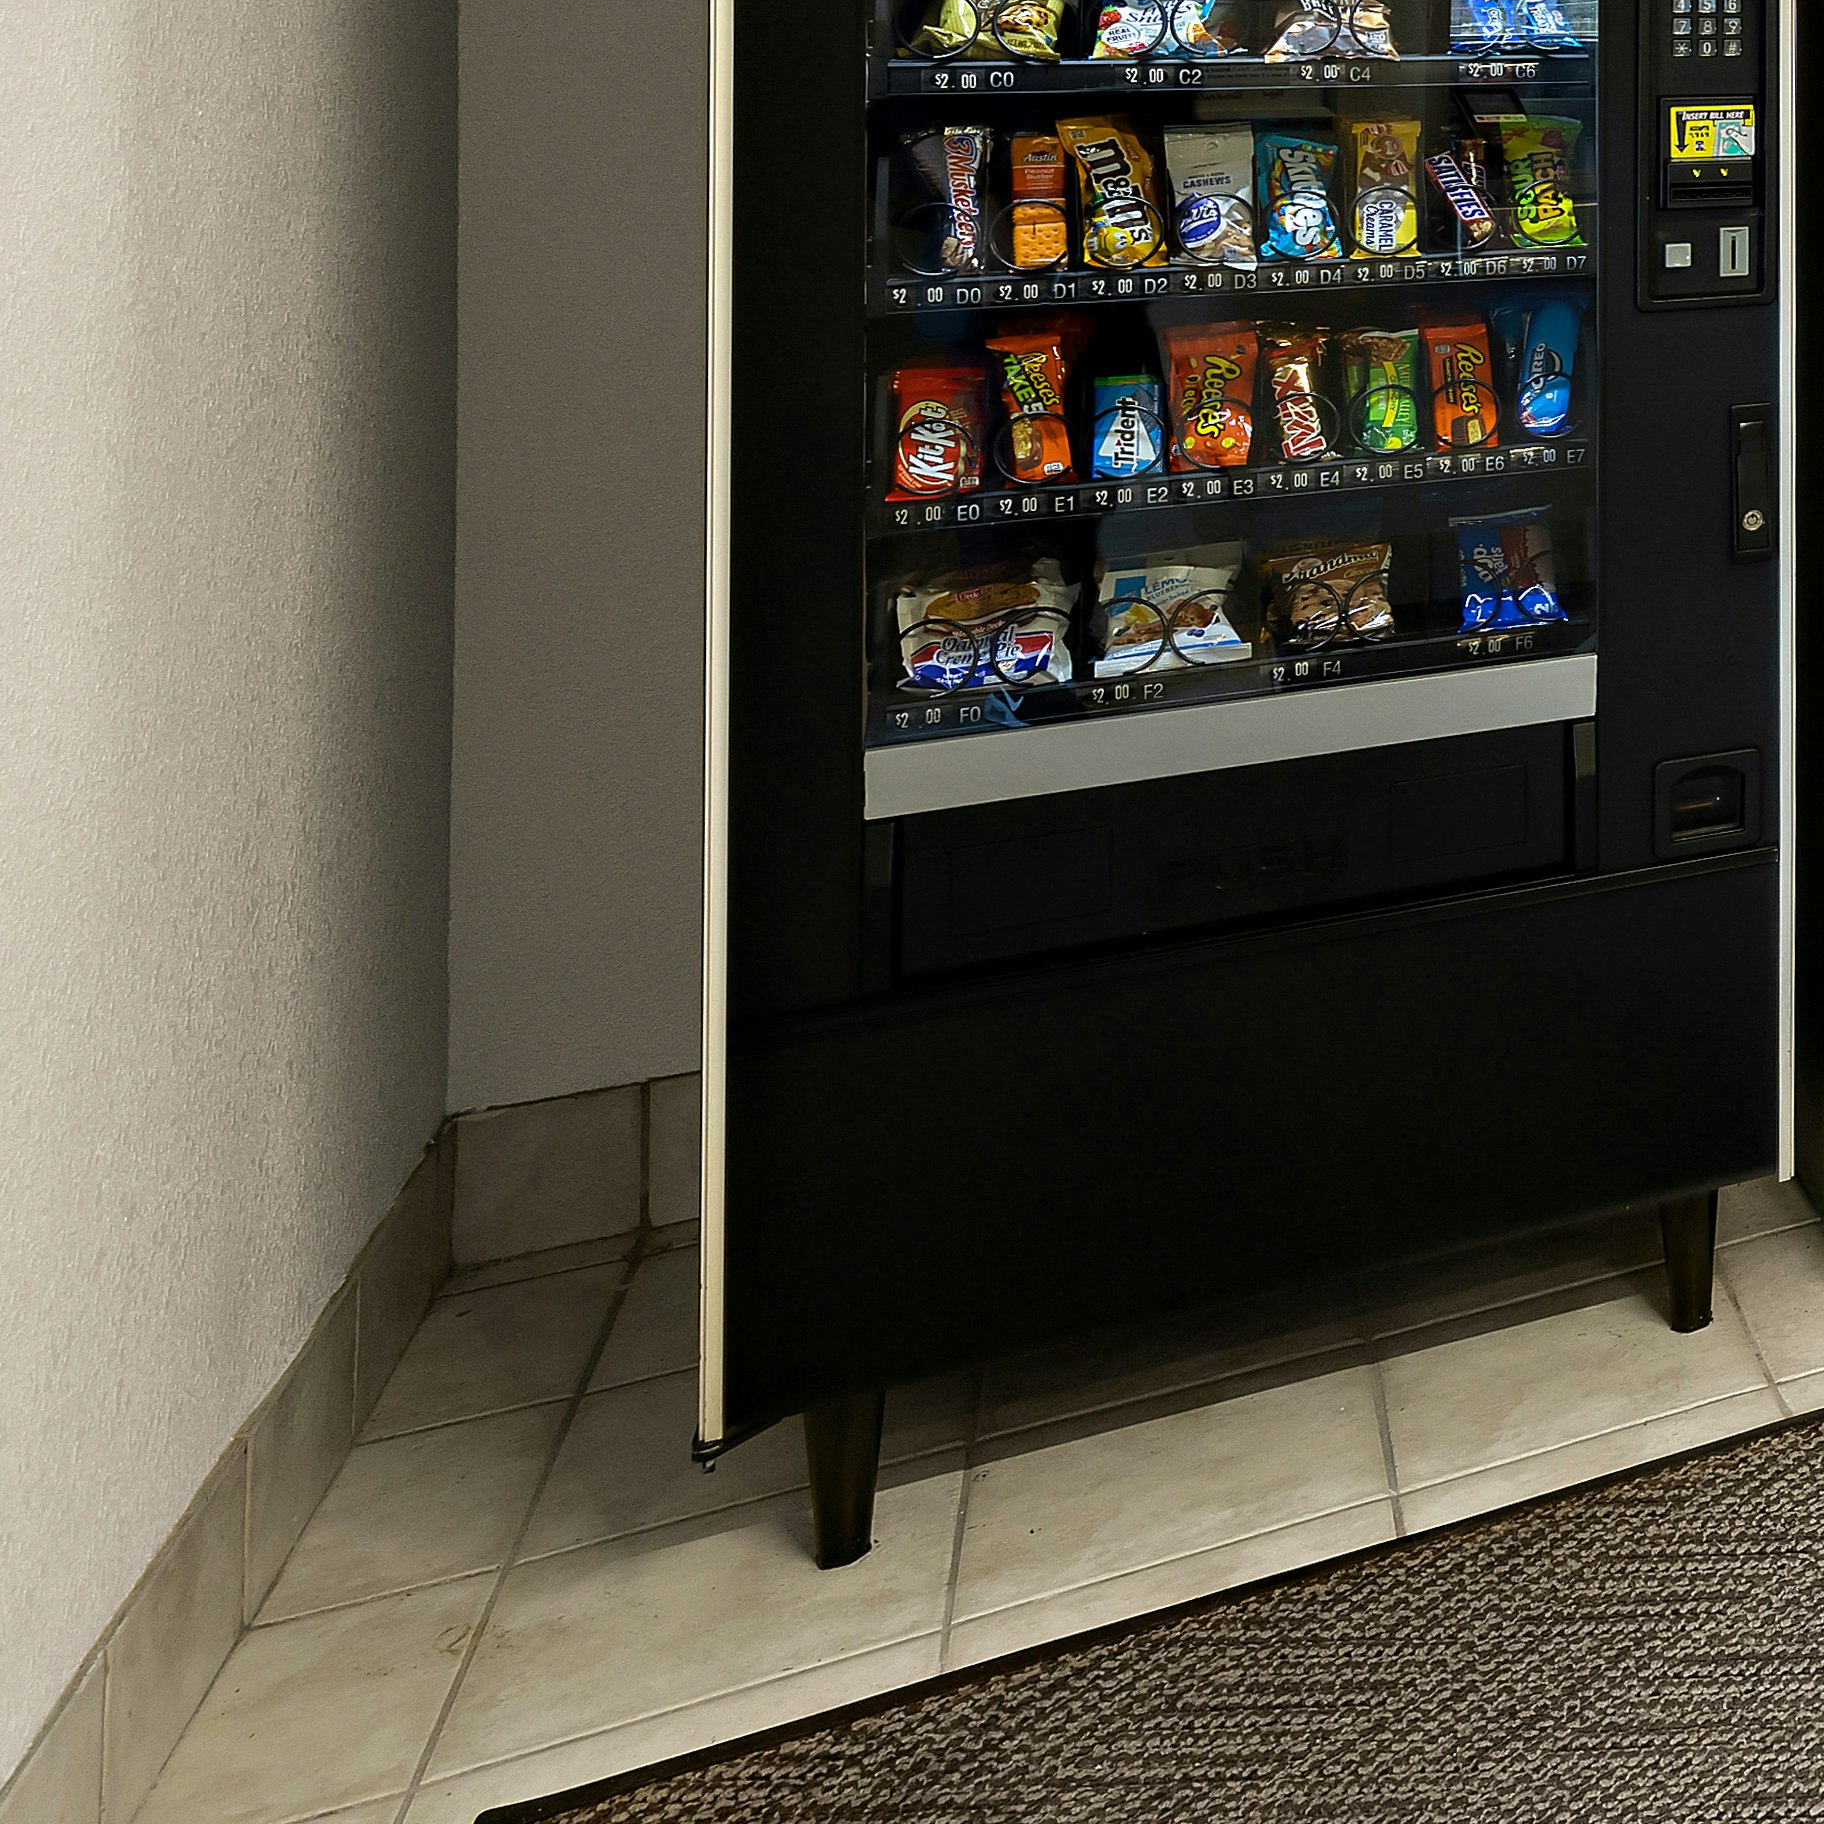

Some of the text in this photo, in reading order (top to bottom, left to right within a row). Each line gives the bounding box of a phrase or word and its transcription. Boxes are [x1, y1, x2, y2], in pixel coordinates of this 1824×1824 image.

[1108, 27, 1131, 36] REAL
[1178, 69, 1202, 85] C2
[1349, 66, 1371, 82] C4
[1515, 63, 1536, 79] C6
[990, 71, 1015, 88] C0
[945, 136, 971, 155] 3
[1023, 154, 1057, 163] Austin
[1182, 175, 1232, 189] CASHEWS
[1364, 204, 1380, 248] Creams
[1378, 199, 1395, 251] CARAMEL
[1404, 264, 1426, 279] D5
[1486, 260, 1507, 275] D6
[1566, 256, 1587, 271] D7
[1234, 275, 1258, 290] D3
[1320, 269, 1342, 284] D4
[1054, 284, 1076, 299] D1
[1144, 278, 1168, 294] D2
[956, 287, 982, 304] D0
[1531, 342, 1546, 390] OREO
[1003, 354, 1034, 404] TAKE
[1021, 352, 1060, 406] Reese's
[1454, 343, 1485, 414] Reese's
[1113, 396, 1139, 469] Trident
[1485, 456, 1505, 472] E6
[1566, 449, 1585, 464] E7
[1320, 471, 1340, 487] E4
[1404, 463, 1423, 479] E5
[1233, 480, 1254, 495] E3
[1147, 488, 1169, 504] E2
[1054, 497, 1075, 512] E1
[957, 505, 981, 522] E0
[1515, 635, 1534, 651] F6
[1323, 661, 1342, 676] F4
[1143, 683, 1164, 700] F2
[960, 706, 981, 722] F0
